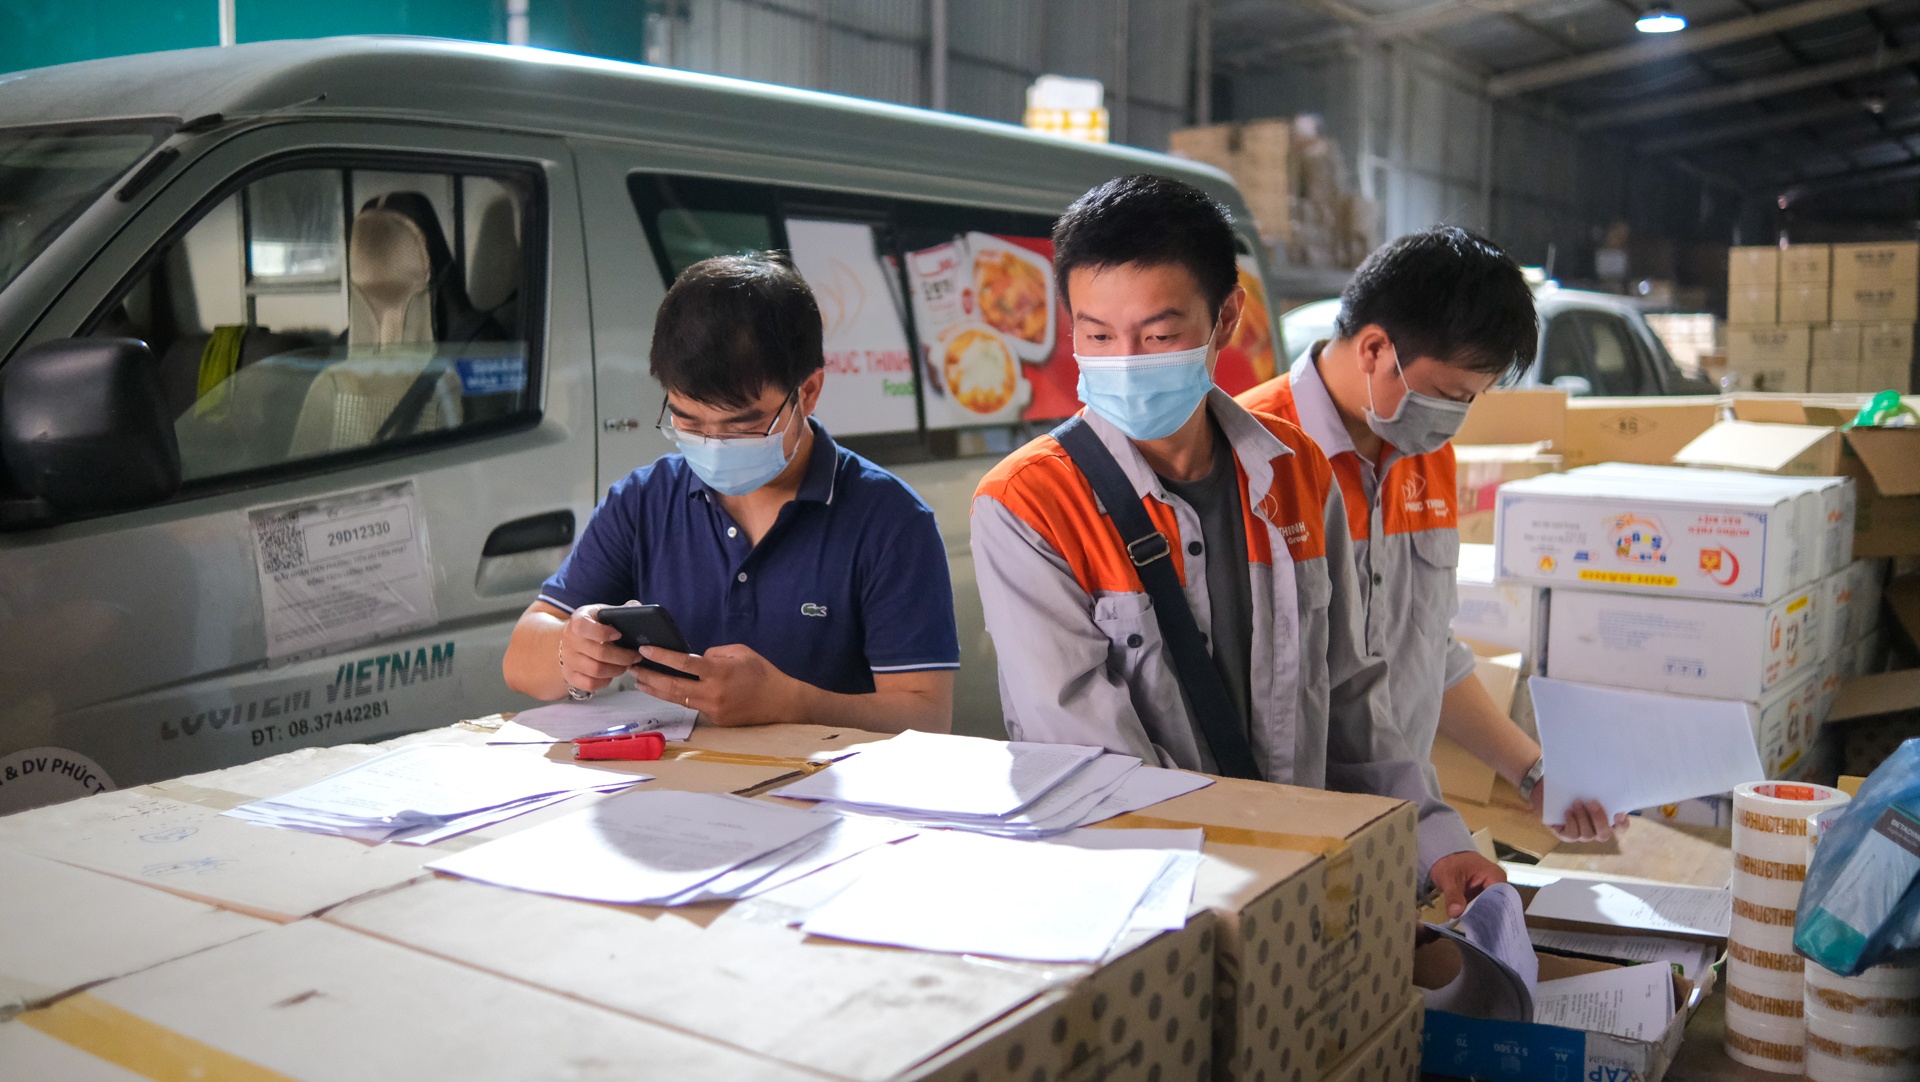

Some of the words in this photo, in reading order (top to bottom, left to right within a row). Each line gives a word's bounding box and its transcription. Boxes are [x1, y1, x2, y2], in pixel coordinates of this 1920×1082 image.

[824, 350, 861, 374] HUC
[327, 521, 391, 547] 29D12330
[1278, 521, 1306, 537] THINH
[1287, 532, 1309, 545] Group
[326, 642, 455, 704] VIETNAM
[288, 699, 390, 739] 08.37442281
[5, 766, 19, 781] &
[22, 757, 48, 775] DV
[51, 758, 97, 788] PHÚC
[1493, 1043, 1511, 1053] 500
[1554, 1052, 1568, 1062] A4
